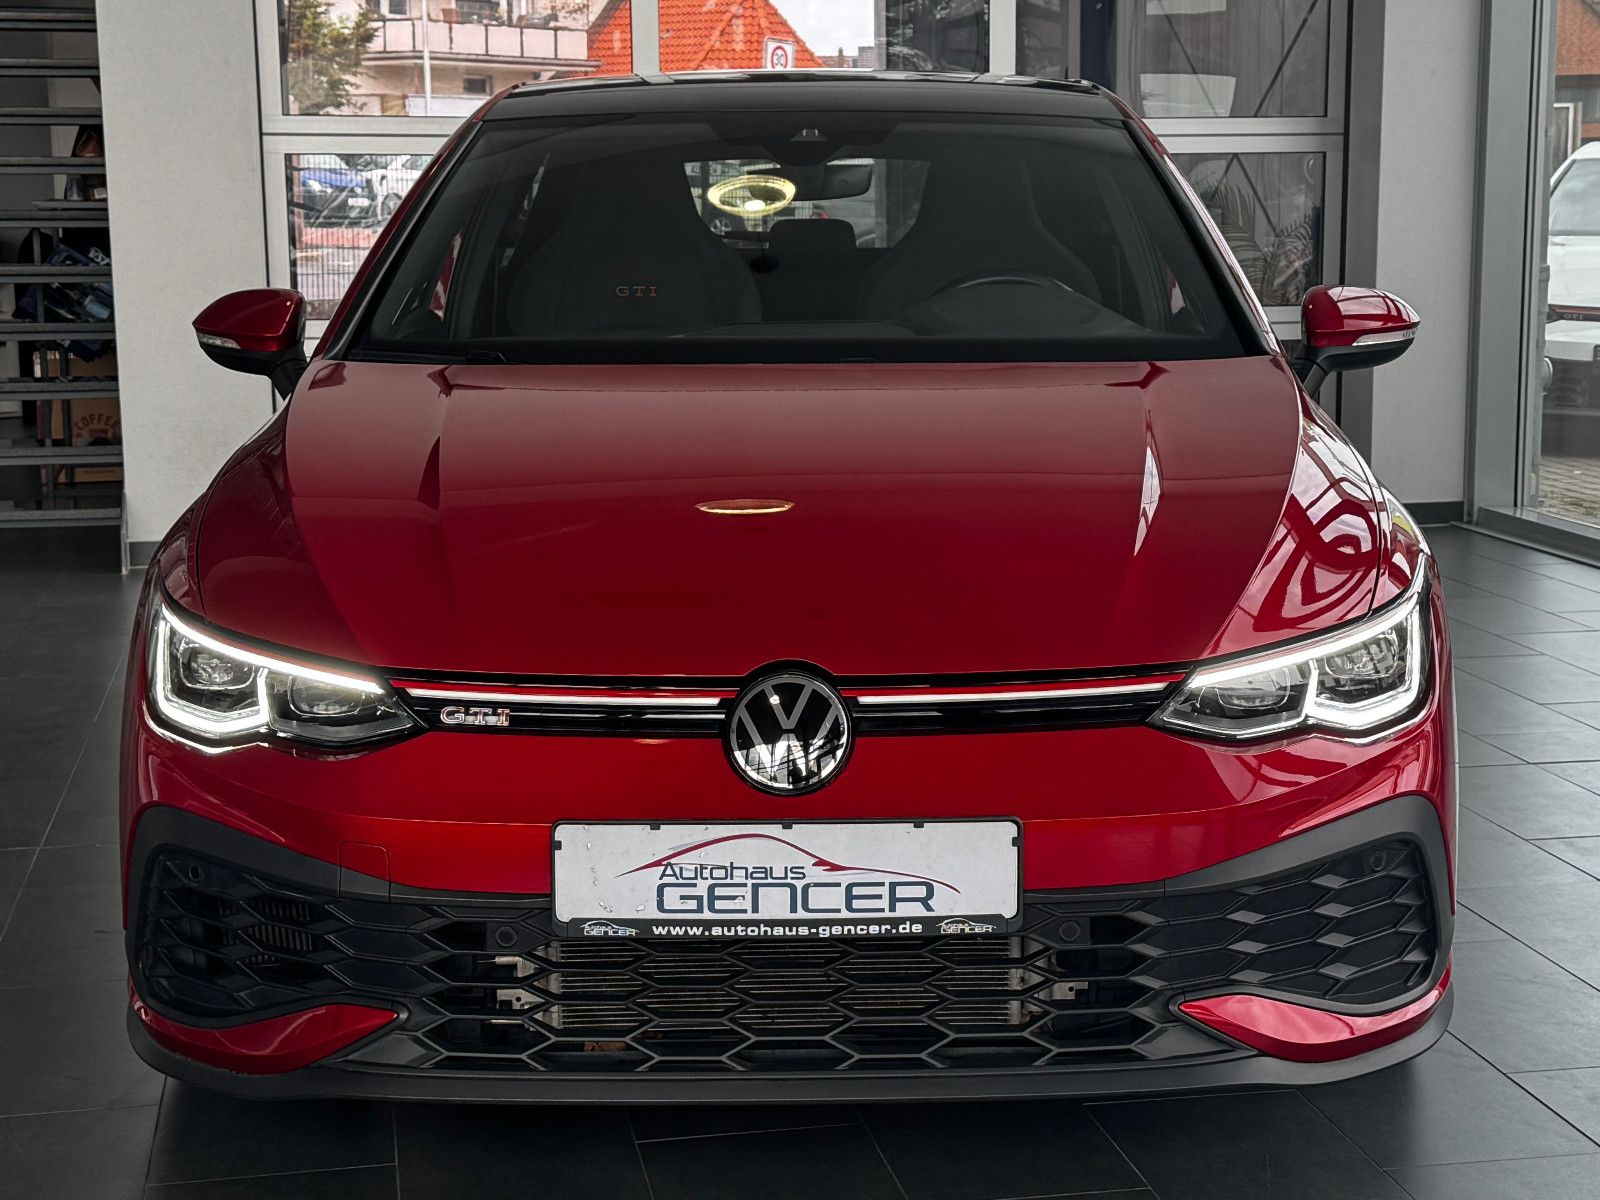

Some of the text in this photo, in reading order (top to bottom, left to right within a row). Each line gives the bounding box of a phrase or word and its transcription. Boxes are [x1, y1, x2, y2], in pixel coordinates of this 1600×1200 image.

[615, 286, 657, 297] GTI
[440, 705, 511, 727] GTI
[658, 861, 807, 881] Autohaus
[656, 880, 936, 914] GENCER
[651, 920, 923, 938] www.autohaus-gencer.de
